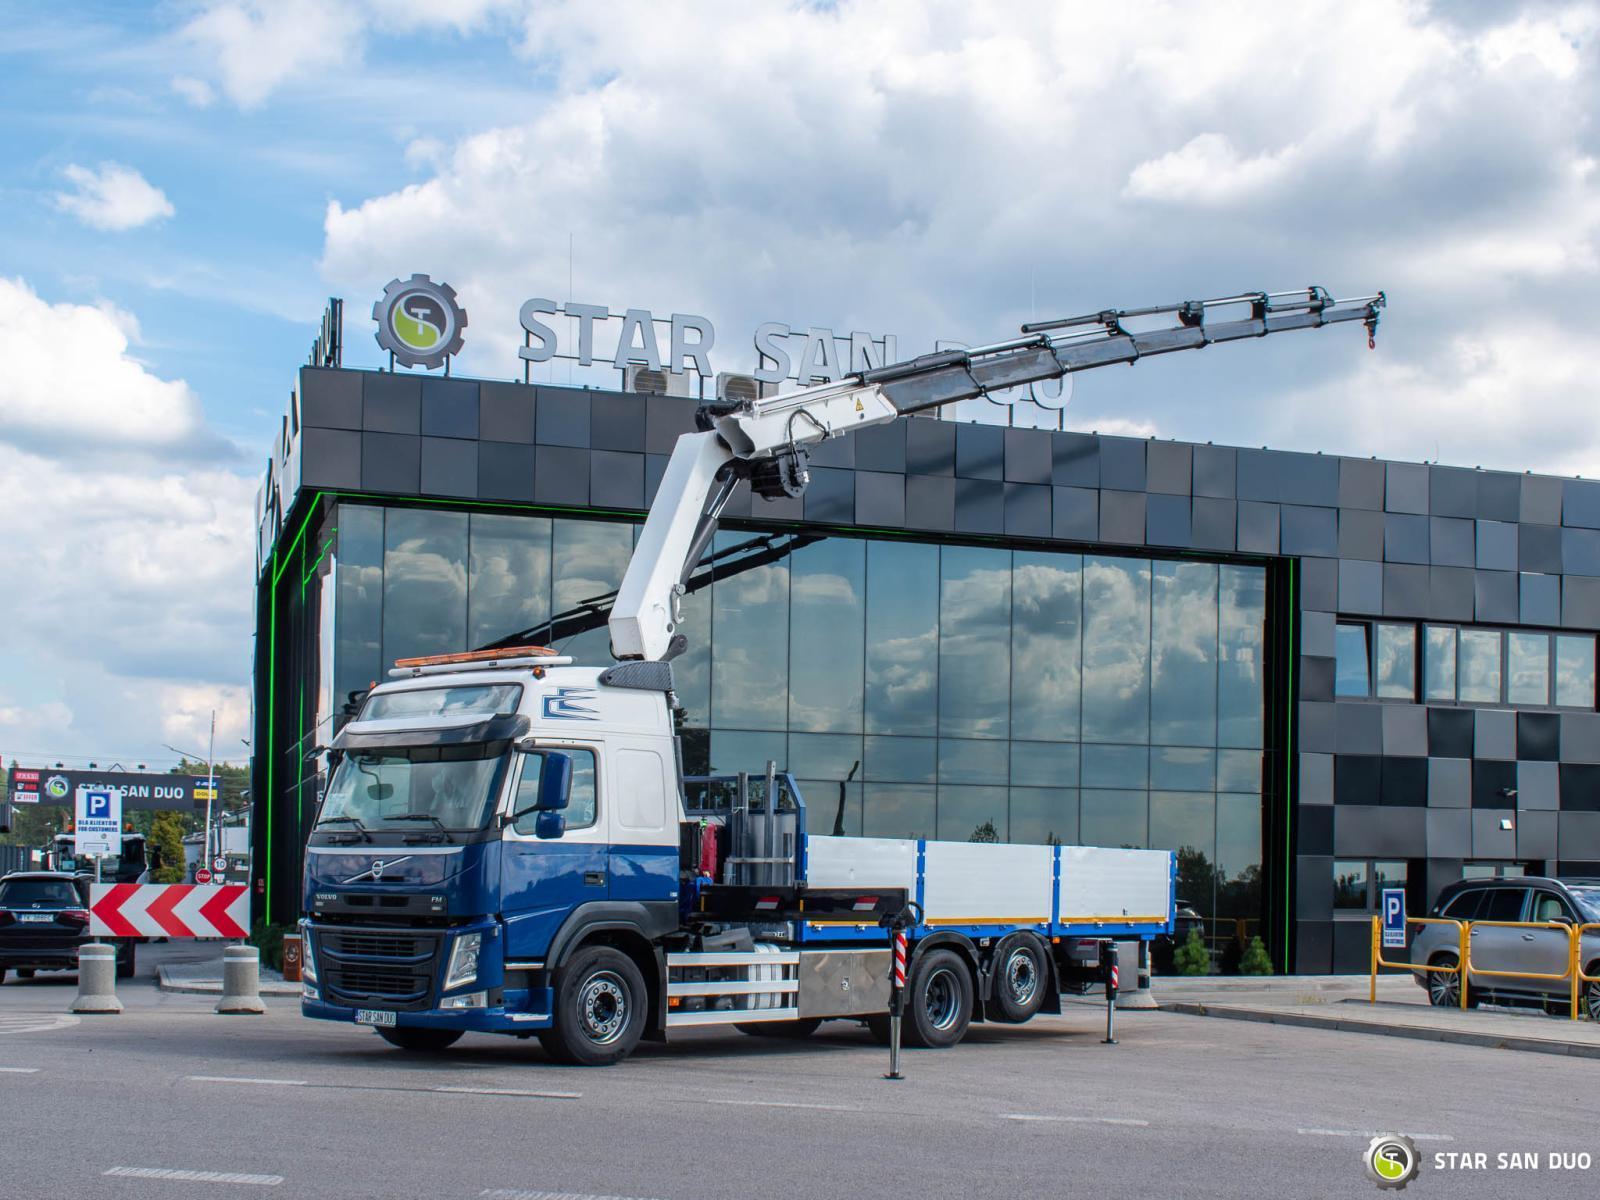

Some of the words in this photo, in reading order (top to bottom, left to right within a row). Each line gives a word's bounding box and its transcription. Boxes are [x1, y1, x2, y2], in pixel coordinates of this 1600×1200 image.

[518, 297, 715, 378] STAR
[753, 321, 897, 387] SAN
[120, 784, 149, 798] SAN
[154, 786, 184, 799] DUO
[90, 795, 107, 815] P
[1388, 897, 1400, 924] P
[358, 1010, 372, 1022] STAR
[373, 1011, 384, 1023] SAN
[384, 1012, 396, 1024] DUO
